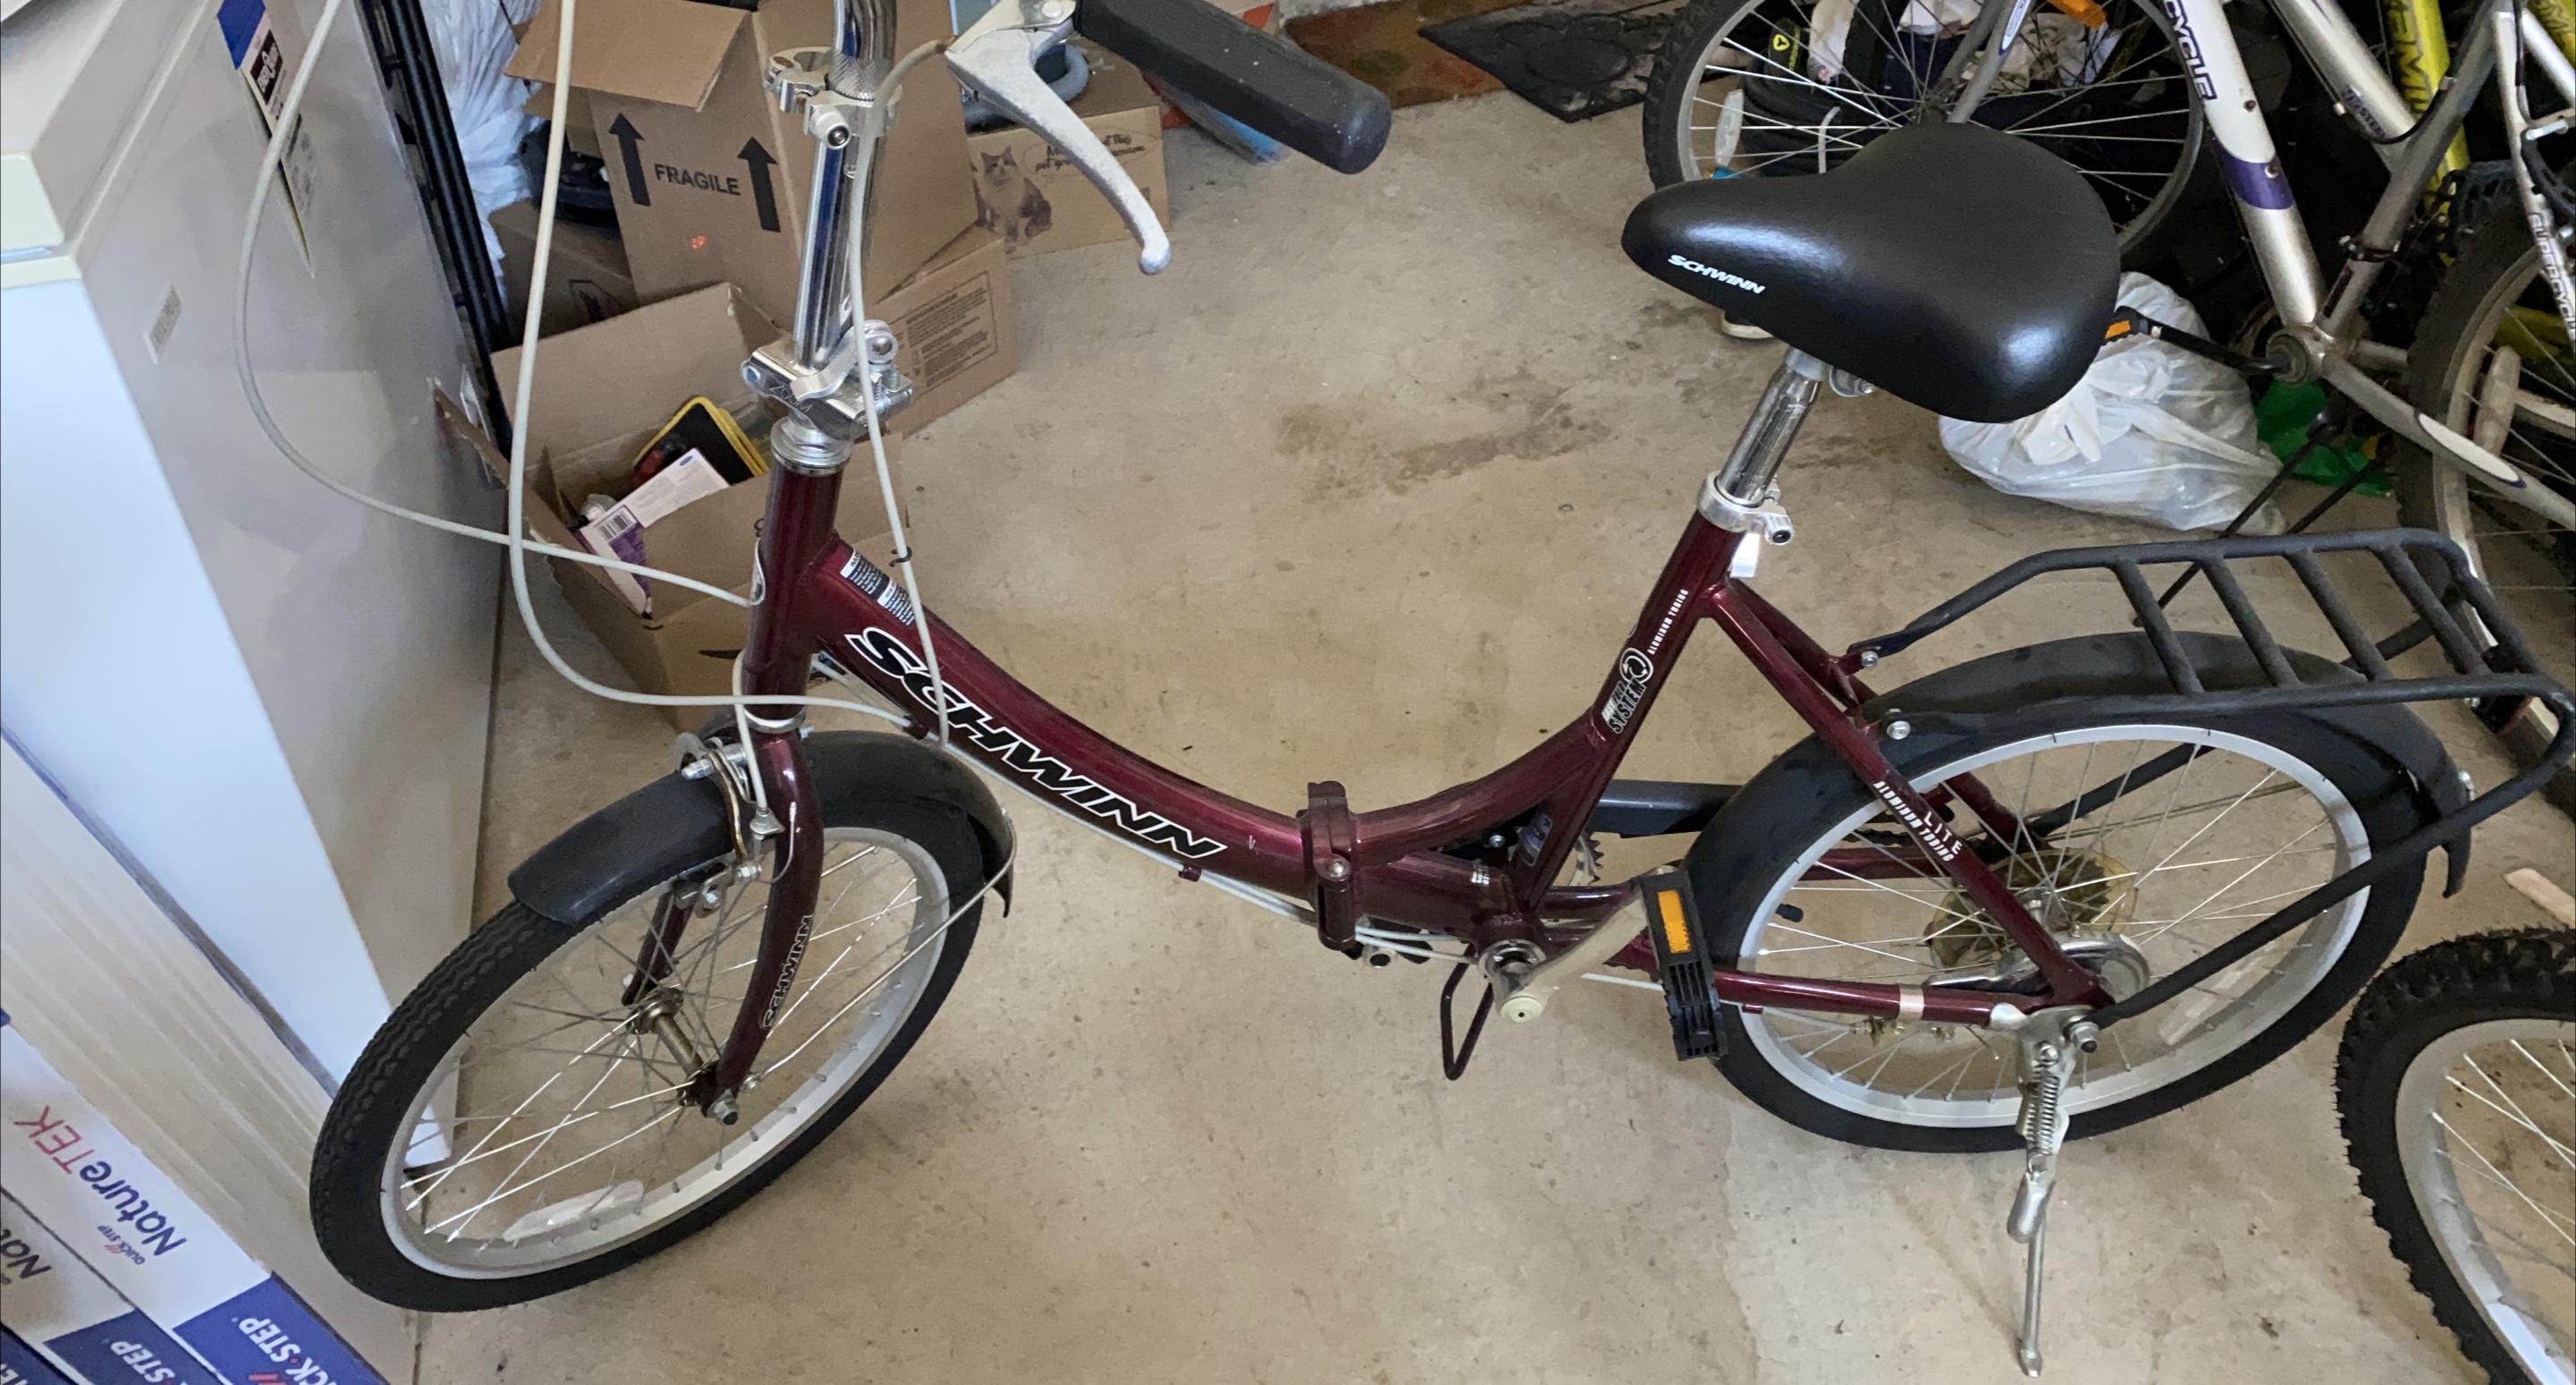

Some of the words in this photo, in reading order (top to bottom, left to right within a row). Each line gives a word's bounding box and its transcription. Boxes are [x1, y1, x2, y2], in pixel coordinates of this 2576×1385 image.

[654, 163, 741, 196] FRAGILE
[1667, 254, 1766, 293] SCHWINN
[1648, 616, 1673, 655] ALUMINUM
[1668, 589, 1689, 616] TUBING
[1609, 677, 1647, 734] SYSTEM
[844, 626, 1229, 859] SCHWINN
[1873, 781, 1923, 828] ALUMINUM
[1919, 828, 1954, 862] TUBING
[1924, 811, 1962, 854] LITE
[762, 914, 814, 1027] SCHWINN
[13, 1105, 187, 1256] NatureTEK
[97, 1225, 121, 1242] STEP
[118, 1240, 146, 1265] QUICK
[110, 1340, 175, 1382] STEP
